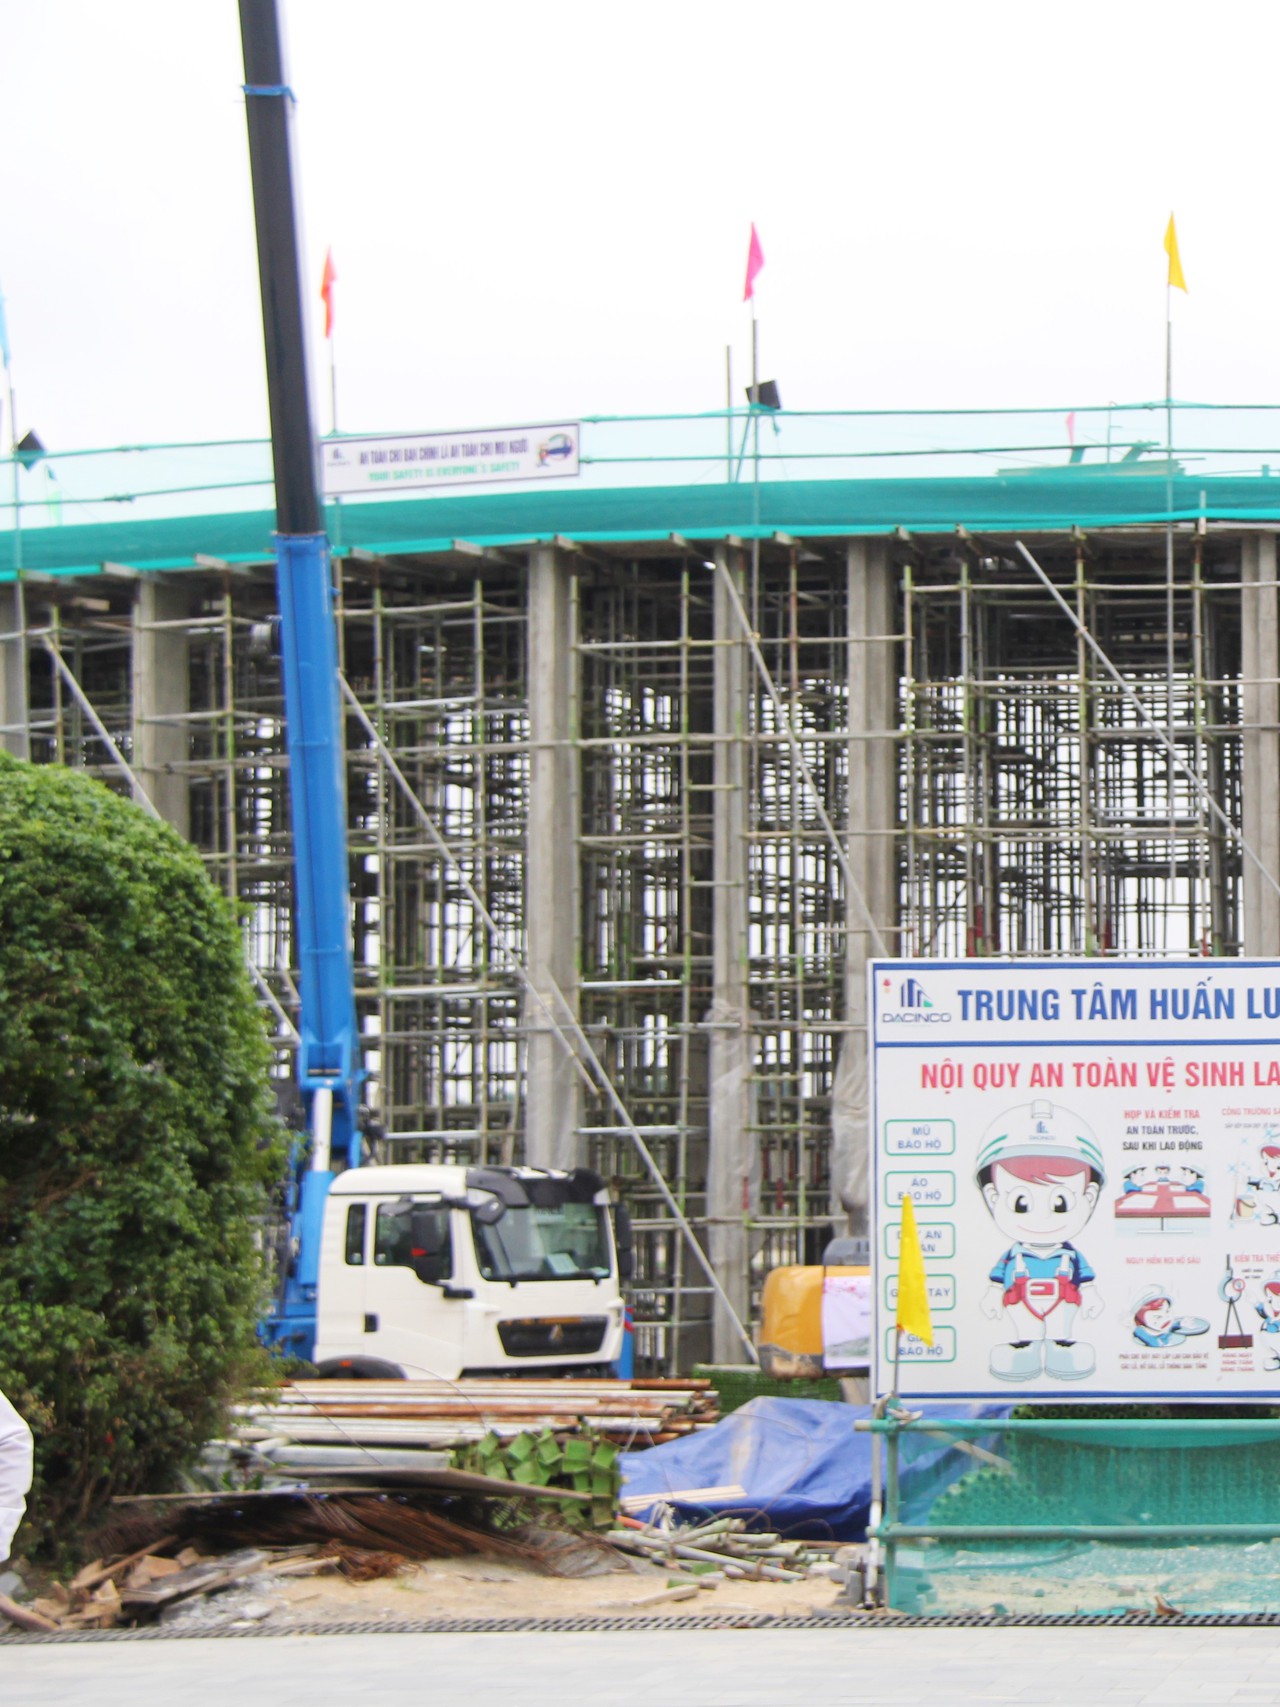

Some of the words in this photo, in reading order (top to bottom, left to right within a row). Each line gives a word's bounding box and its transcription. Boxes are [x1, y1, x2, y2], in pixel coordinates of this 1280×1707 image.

[957, 989, 1060, 1021] TRUNG
[1070, 982, 1138, 1020] TÂM
[1149, 976, 1236, 1020] HUẤN
[882, 1012, 951, 1023] DACINCO
[920, 1058, 963, 1094] NỘI
[972, 1062, 1021, 1091] QUY
[1029, 1062, 1063, 1088] AN
[1072, 1056, 1138, 1088] TOÀN
[1146, 1056, 1176, 1093] VỆ
[1184, 1061, 1244, 1087] SINH
[1184, 1109, 1200, 1118] TRA
[1126, 1125, 1139, 1135] AN
[1122, 1141, 1139, 1150] SAU
[1142, 1141, 1157, 1150] KHI
[1159, 1141, 1176, 1150] LAO
[925, 1230, 942, 1239] AN
[928, 1287, 951, 1297] TAY
